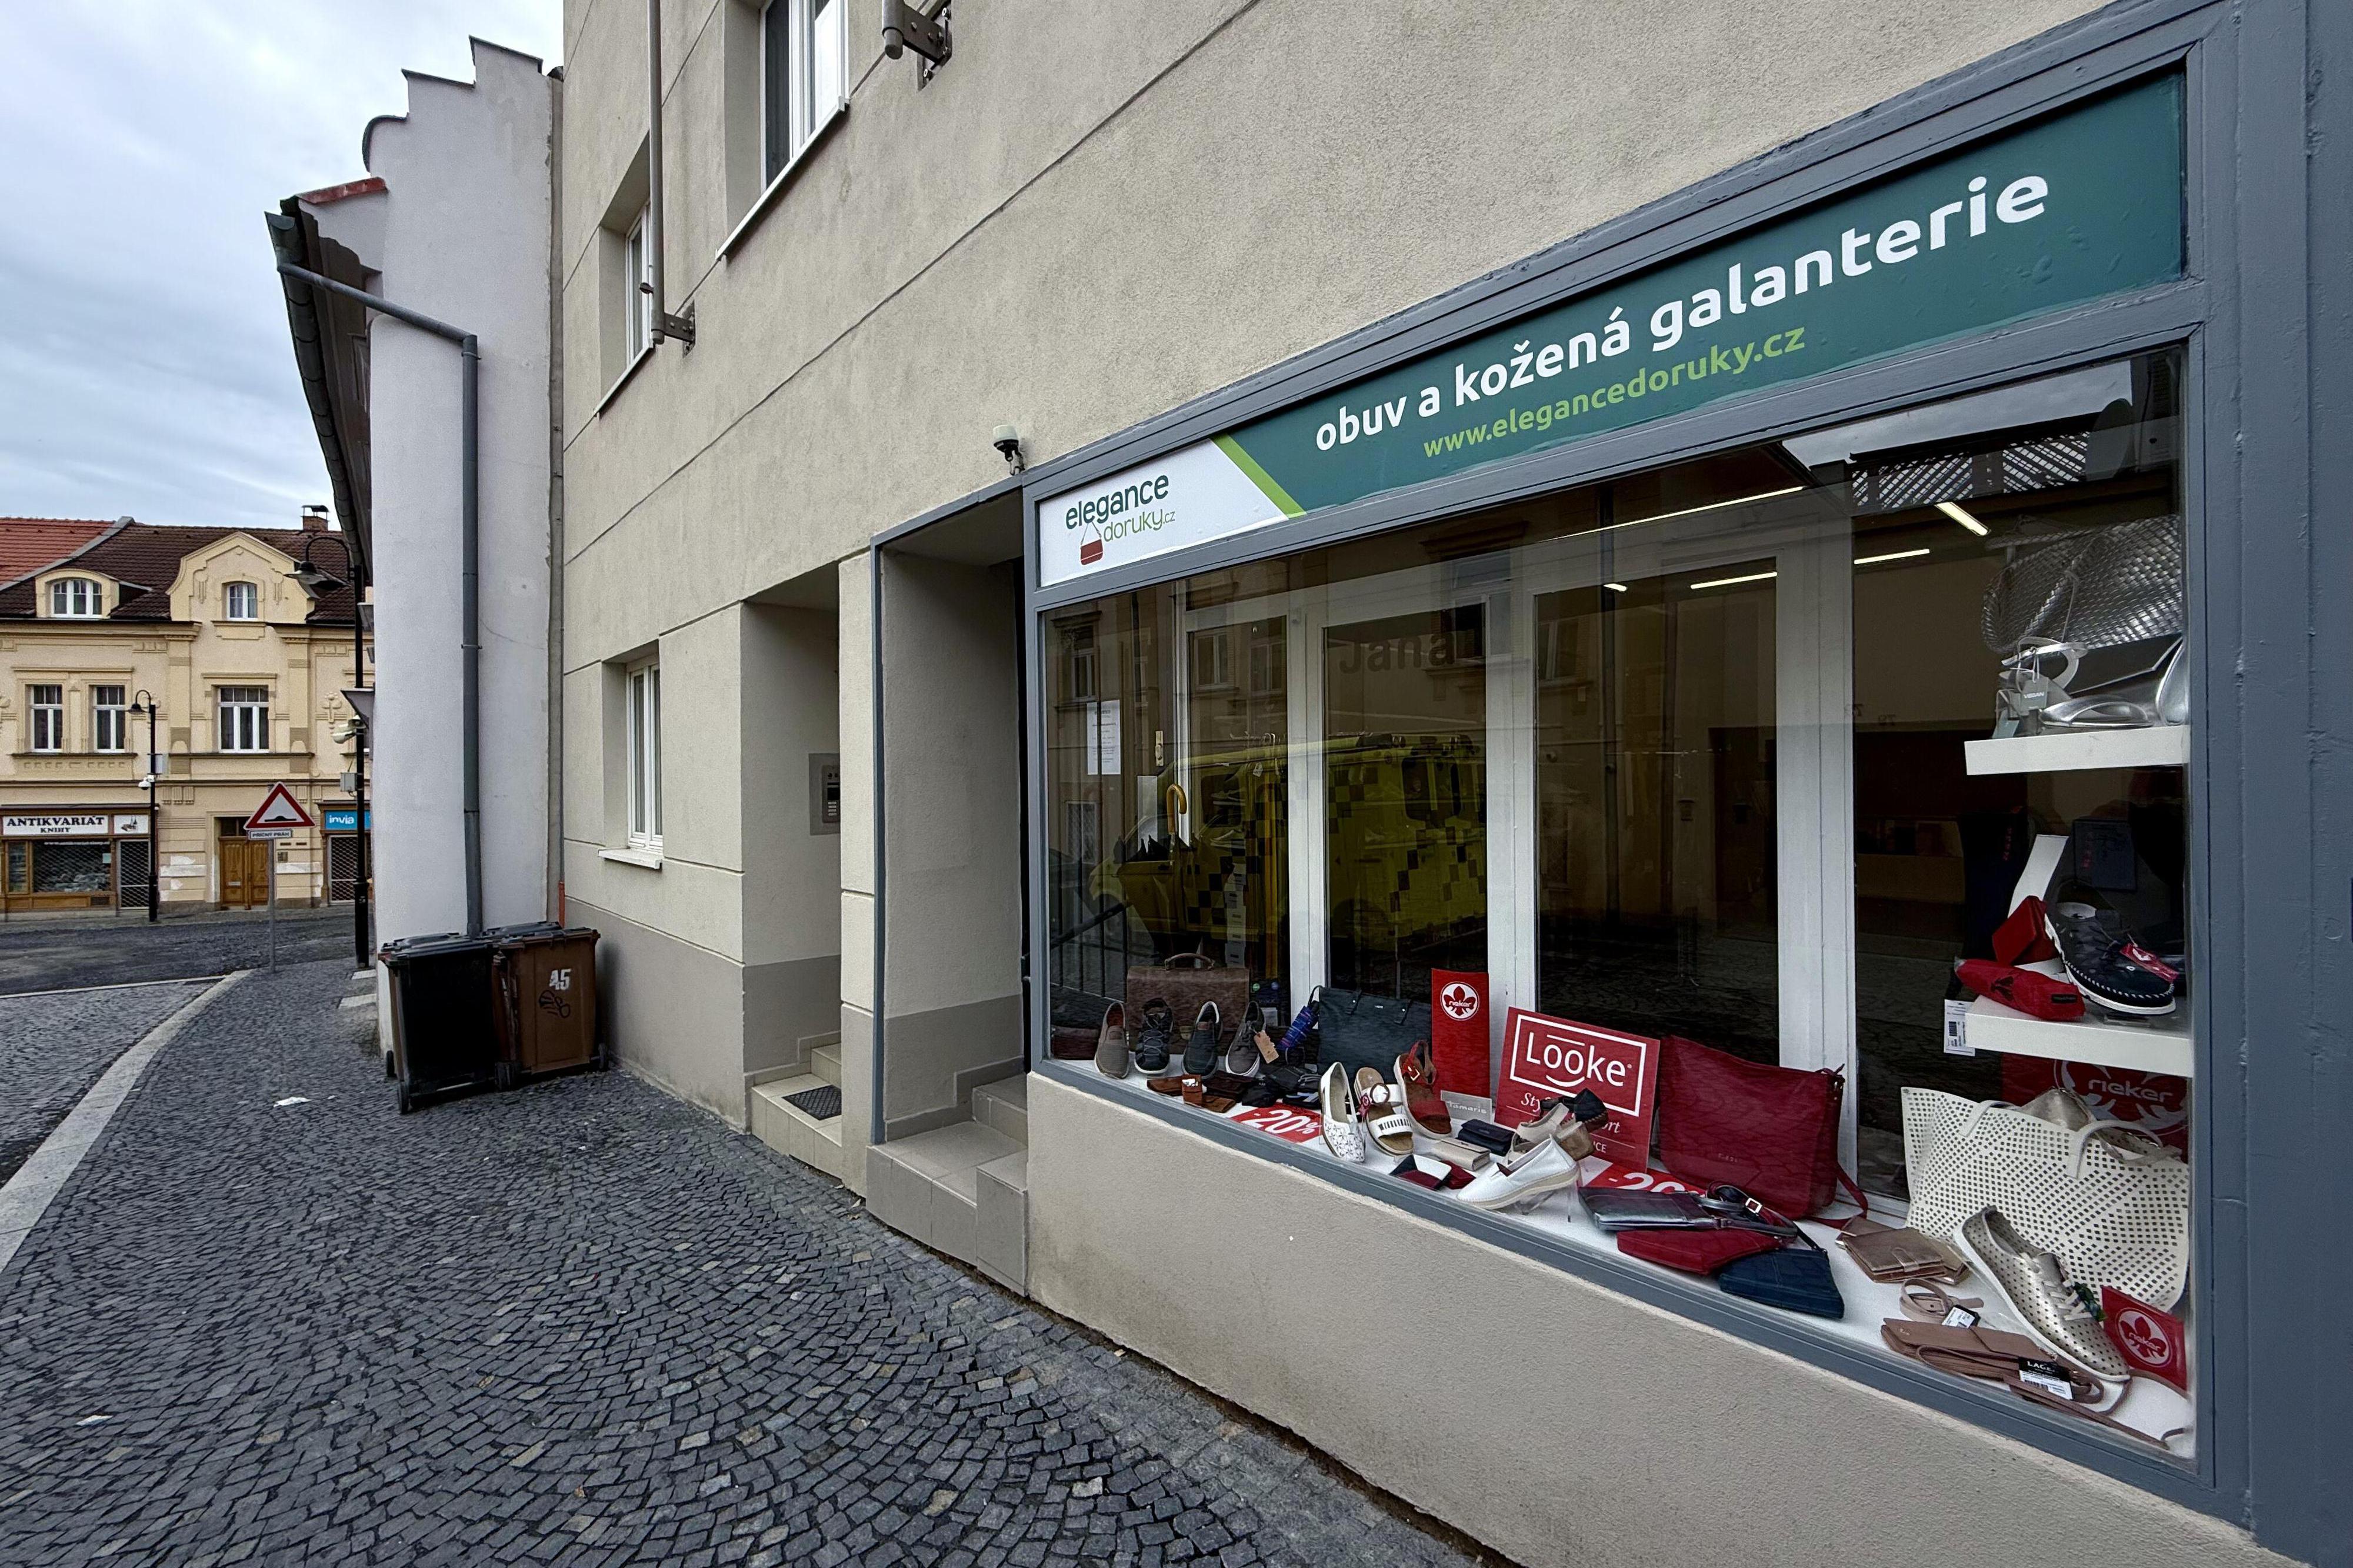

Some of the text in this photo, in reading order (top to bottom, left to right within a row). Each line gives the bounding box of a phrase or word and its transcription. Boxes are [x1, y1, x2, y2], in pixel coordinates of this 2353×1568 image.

[1317, 176, 2048, 451] obuv a kožená galanterie
[1424, 327, 1805, 458] www.elegancedoruky.cz
[1066, 475, 1169, 532] elegance
[1103, 509, 1175, 542] doruky.cz
[1339, 632, 1456, 674] Jana
[6, 816, 105, 826] ANTIKVARIÁT
[329, 815, 354, 824] invia
[549, 968, 572, 991] 45
[1447, 1100, 1487, 1114] Tamaris
[1241, 1109, 1323, 1135] -20%
